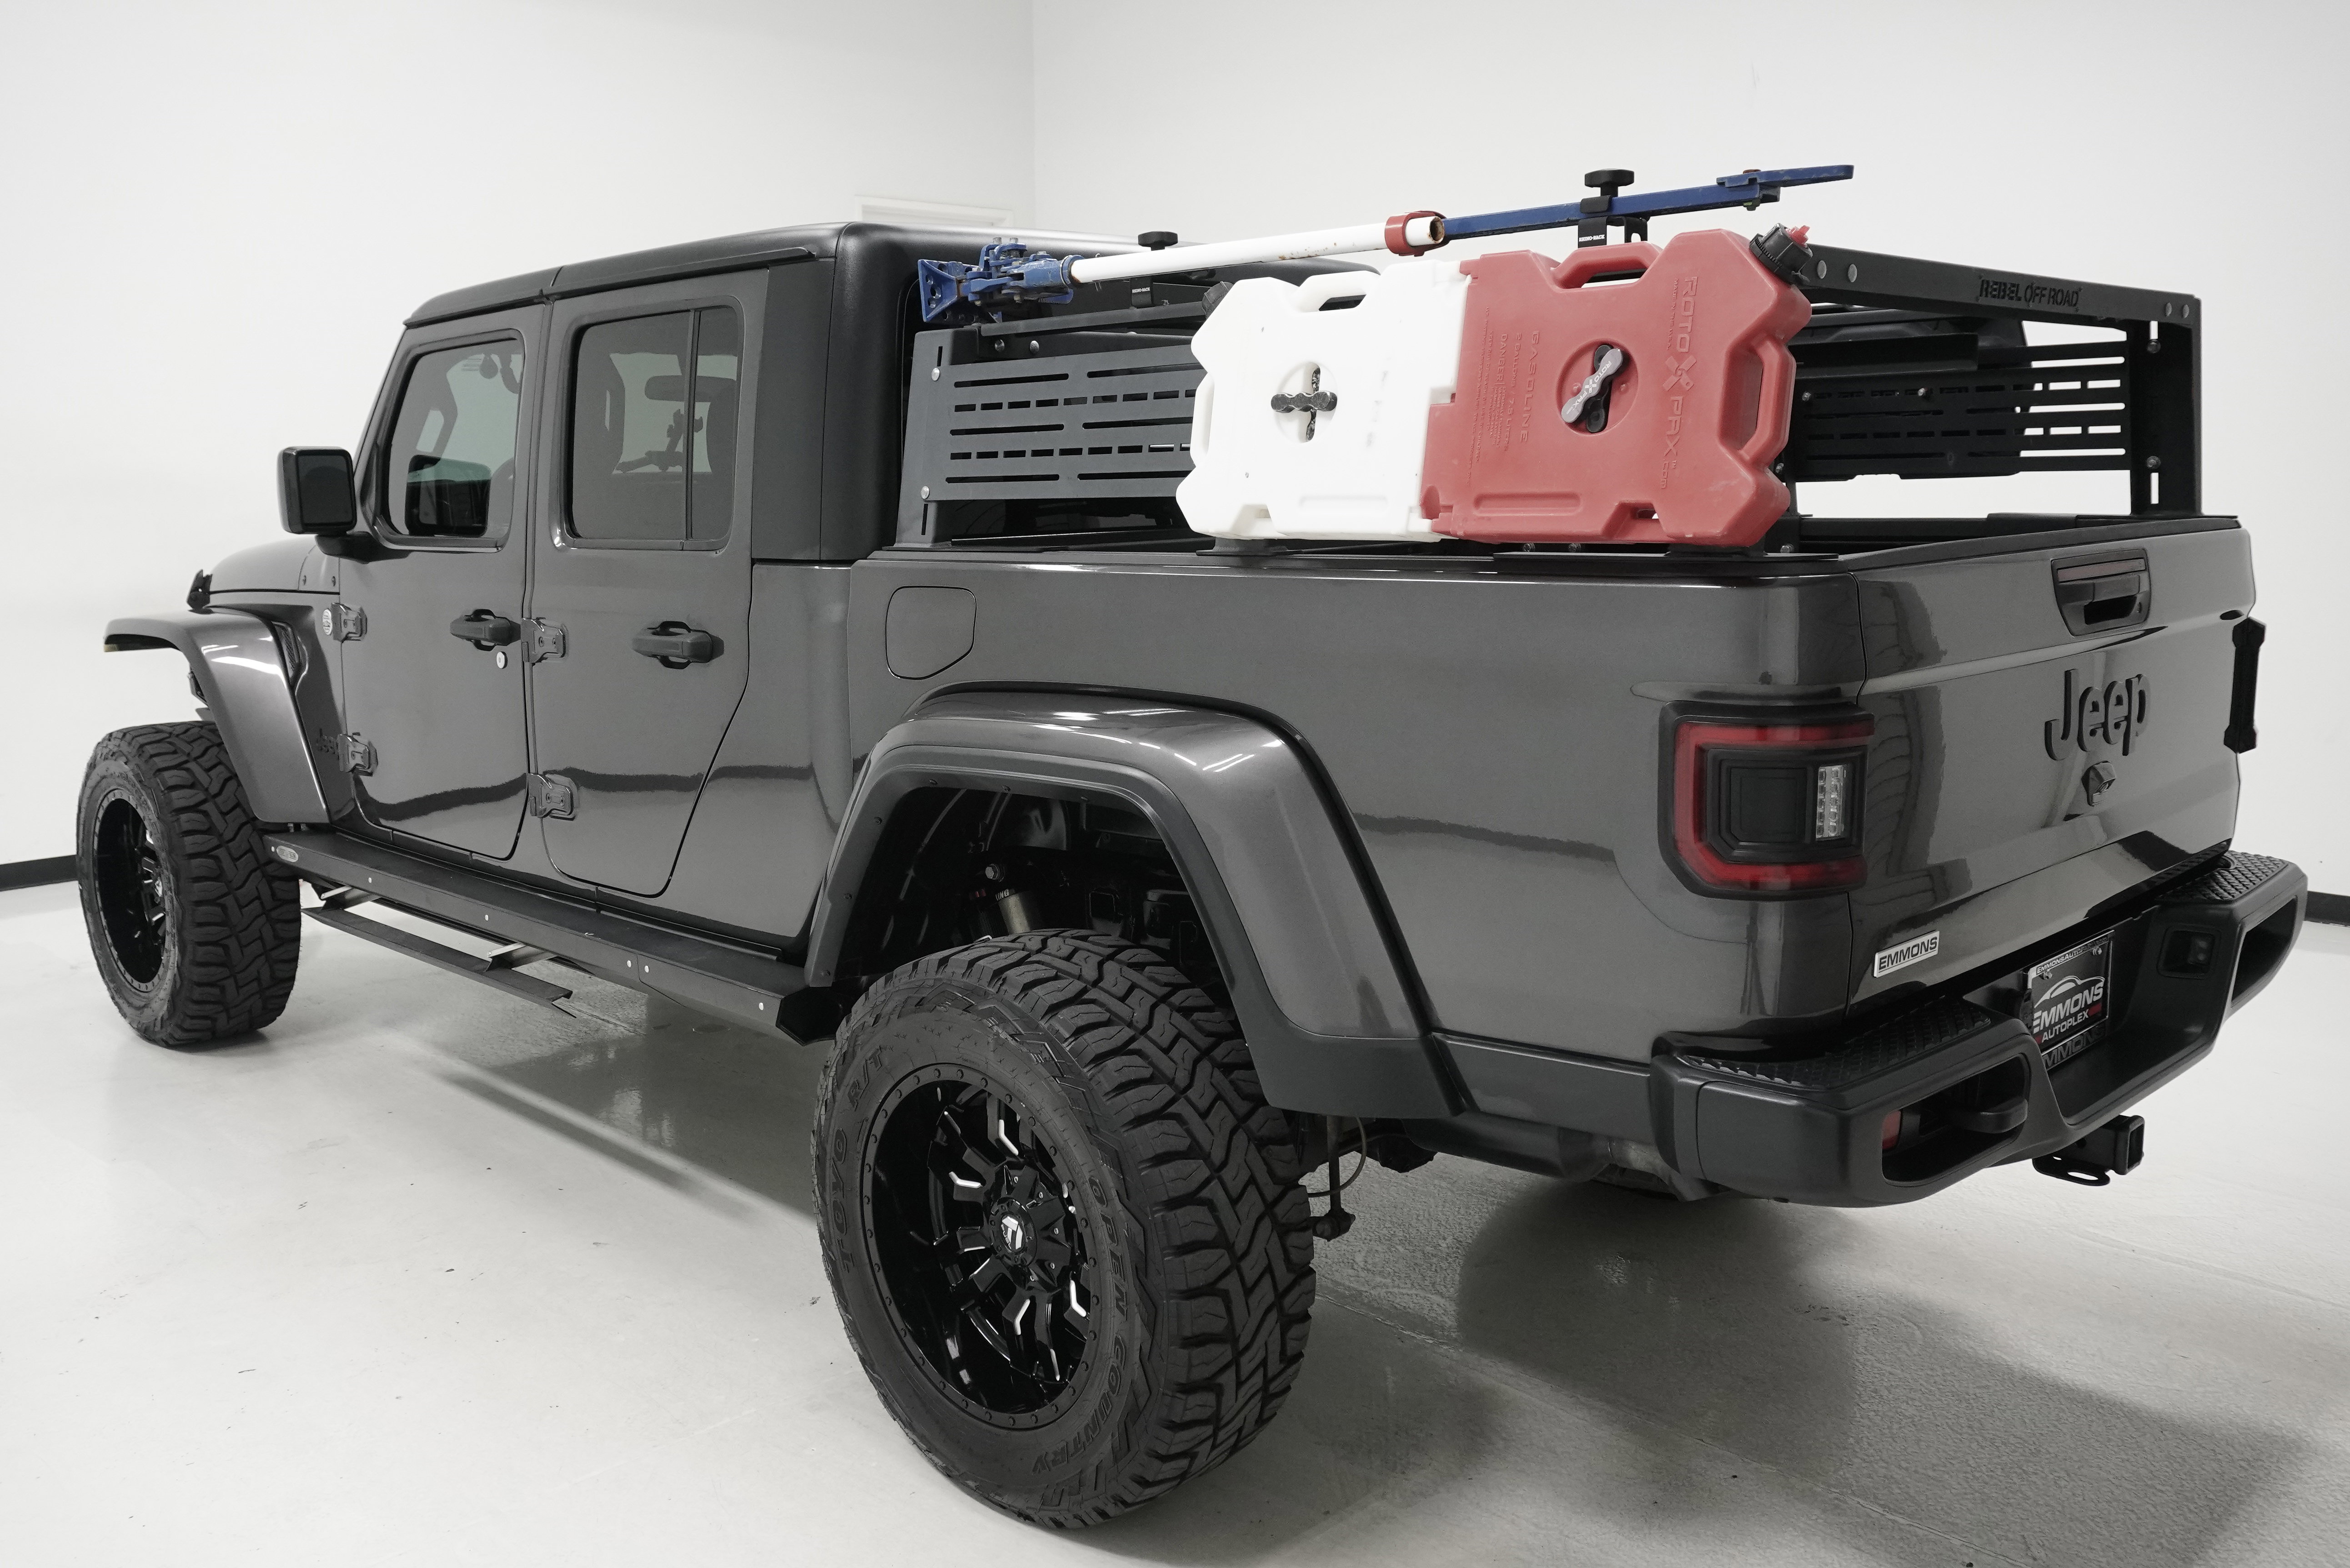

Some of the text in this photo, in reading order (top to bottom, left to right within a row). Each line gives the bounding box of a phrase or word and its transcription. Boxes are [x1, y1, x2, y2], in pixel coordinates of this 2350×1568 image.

[1677, 276, 1698, 353] ROTO
[1979, 279, 2022, 302] REBEL
[1497, 333, 1507, 381] DANGER
[1521, 331, 1540, 443] GASOLINE
[1594, 361, 1612, 382] ROTO
[2044, 668, 2151, 761] Jeep
[1878, 936, 1938, 970] EMMONS
[2033, 982, 2104, 1034] EMMONS
[2041, 1008, 2089, 1043] AUTOPLEX
[847, 1045, 882, 1112] R/T
[832, 1127, 855, 1274] TOYO
[1088, 1176, 1127, 1322] OPEN
[1031, 1334, 1126, 1473] COUNTRY
